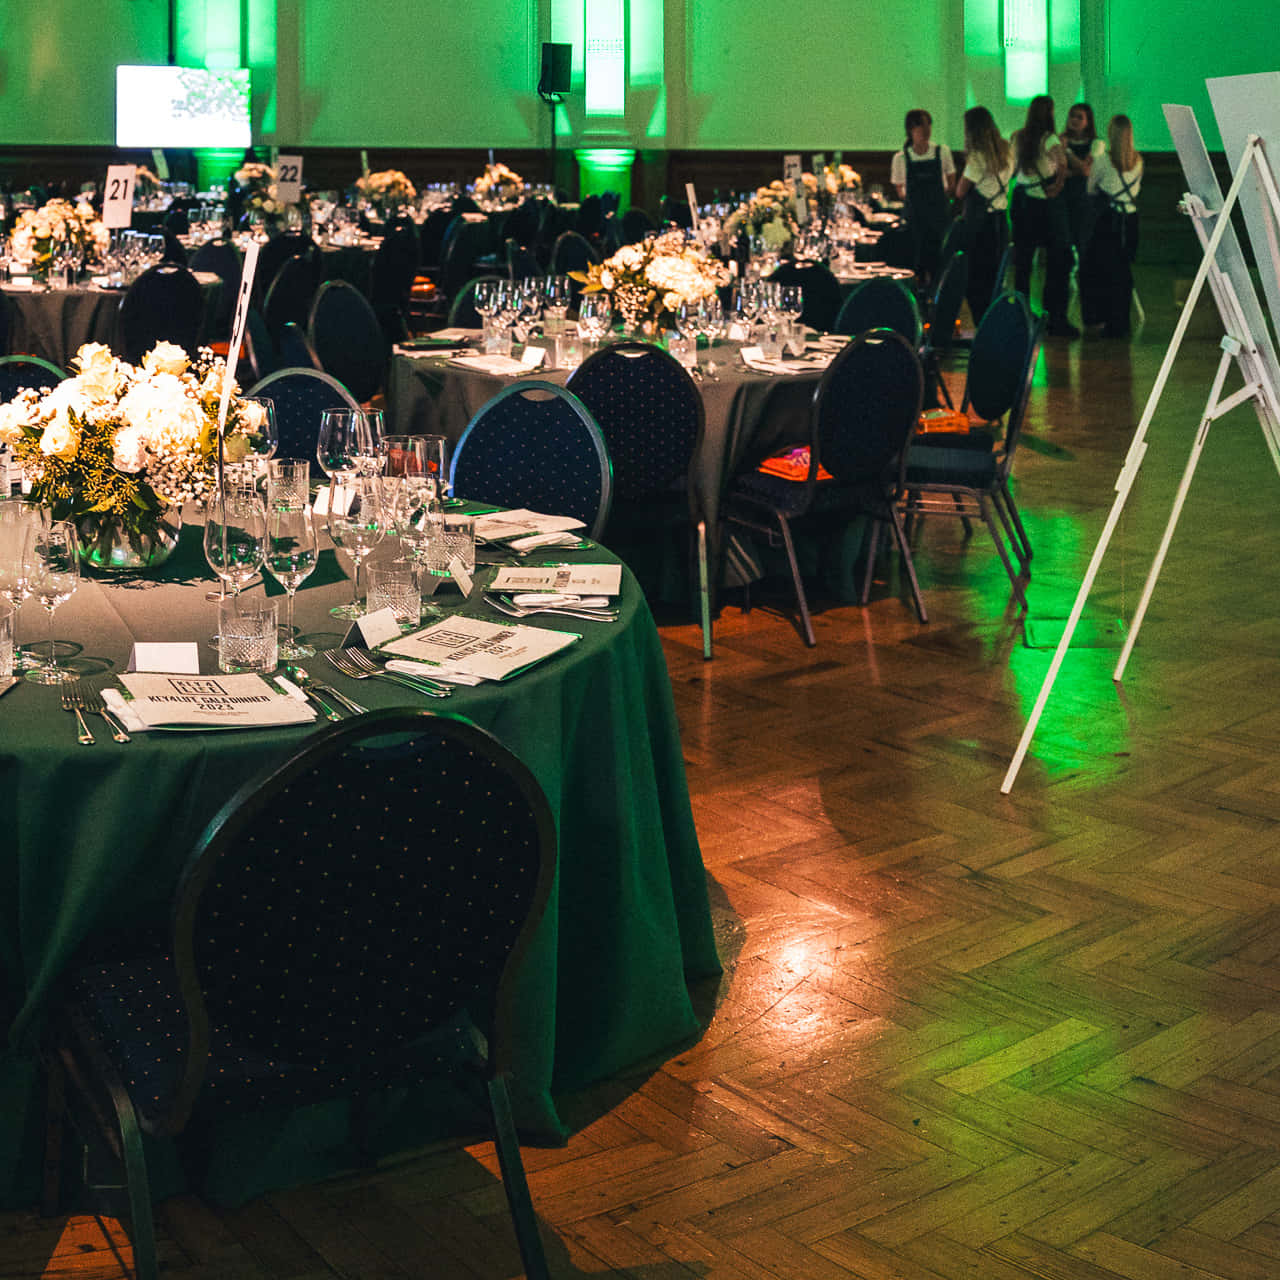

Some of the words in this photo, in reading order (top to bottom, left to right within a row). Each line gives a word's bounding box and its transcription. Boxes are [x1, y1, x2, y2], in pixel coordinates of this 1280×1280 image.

[280, 165, 298, 182] 22
[109, 179, 128, 200] 21
[148, 695, 197, 703] KEY4LIFE
[200, 696, 229, 704] GALA
[229, 695, 271, 703] DINNER
